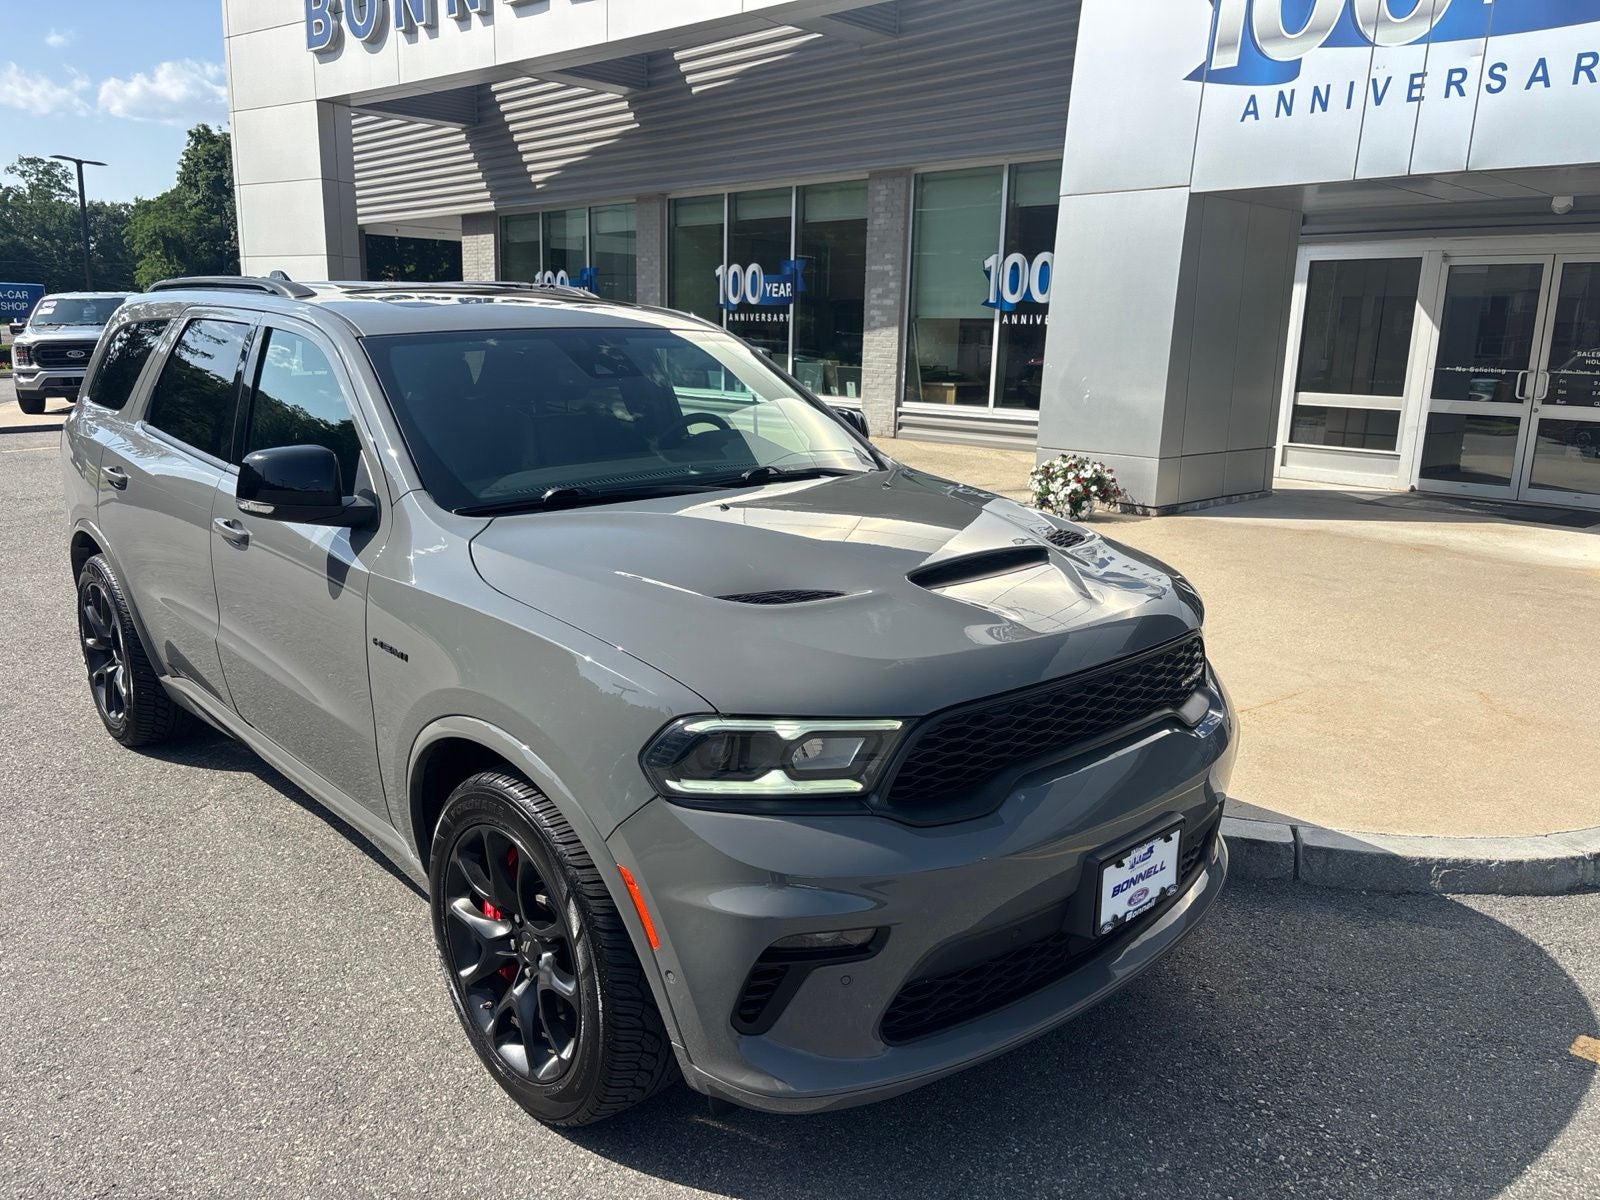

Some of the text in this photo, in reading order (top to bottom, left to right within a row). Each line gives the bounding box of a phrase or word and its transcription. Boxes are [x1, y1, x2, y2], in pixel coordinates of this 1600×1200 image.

[1240, 51, 1600, 122] ANNIVERSAR
[715, 263, 792, 305] 100 YEAR
[984, 251, 1053, 304] 100
[0, 302, 28, 310] SHOP
[728, 313, 790, 322] ANNIVERSARY
[1111, 861, 1166, 898] BONNELL
[1125, 897, 1157, 922] Bonnell
